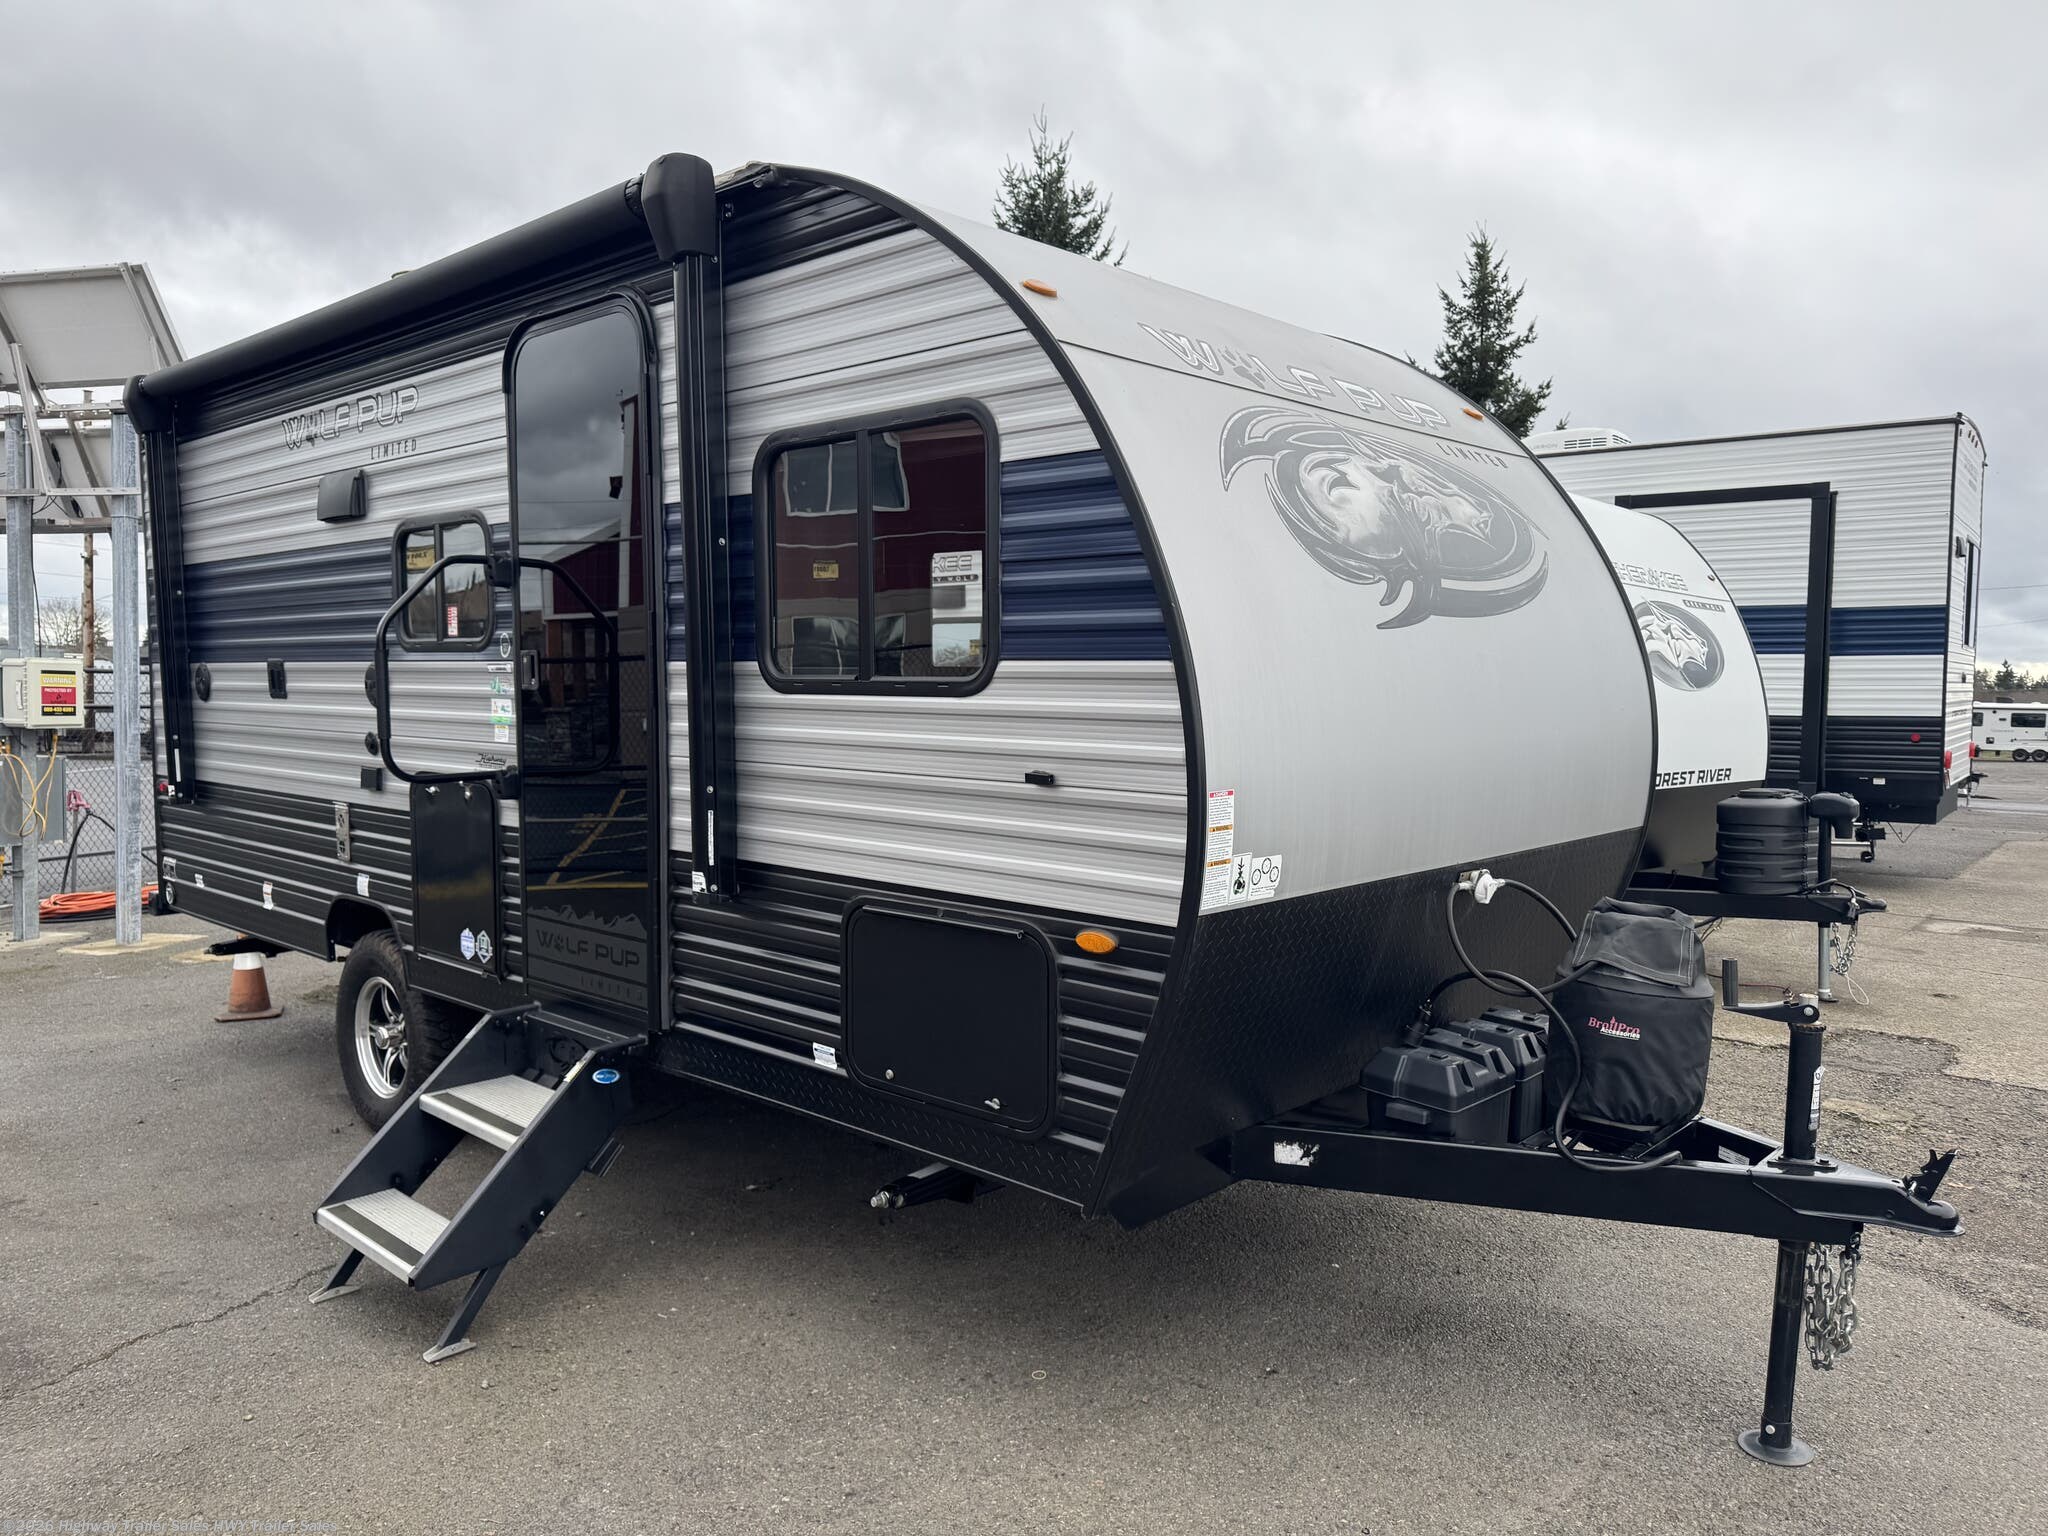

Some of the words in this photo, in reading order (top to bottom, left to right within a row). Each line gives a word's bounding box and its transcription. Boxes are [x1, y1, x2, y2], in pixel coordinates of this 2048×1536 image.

[356, 385, 419, 432] PUP
[1330, 375, 1452, 431] PUP
[370, 438, 417, 460] LIMITED
[1436, 442, 1509, 469] LIMITED
[1611, 561, 1689, 592] HEROKEE
[1655, 770, 1695, 787] OREST
[1697, 767, 1732, 784] RIVER
[595, 943, 640, 968] PUP
[1587, 1016, 1640, 1034] BroilPro
[1600, 1026, 1640, 1039] Accessories
